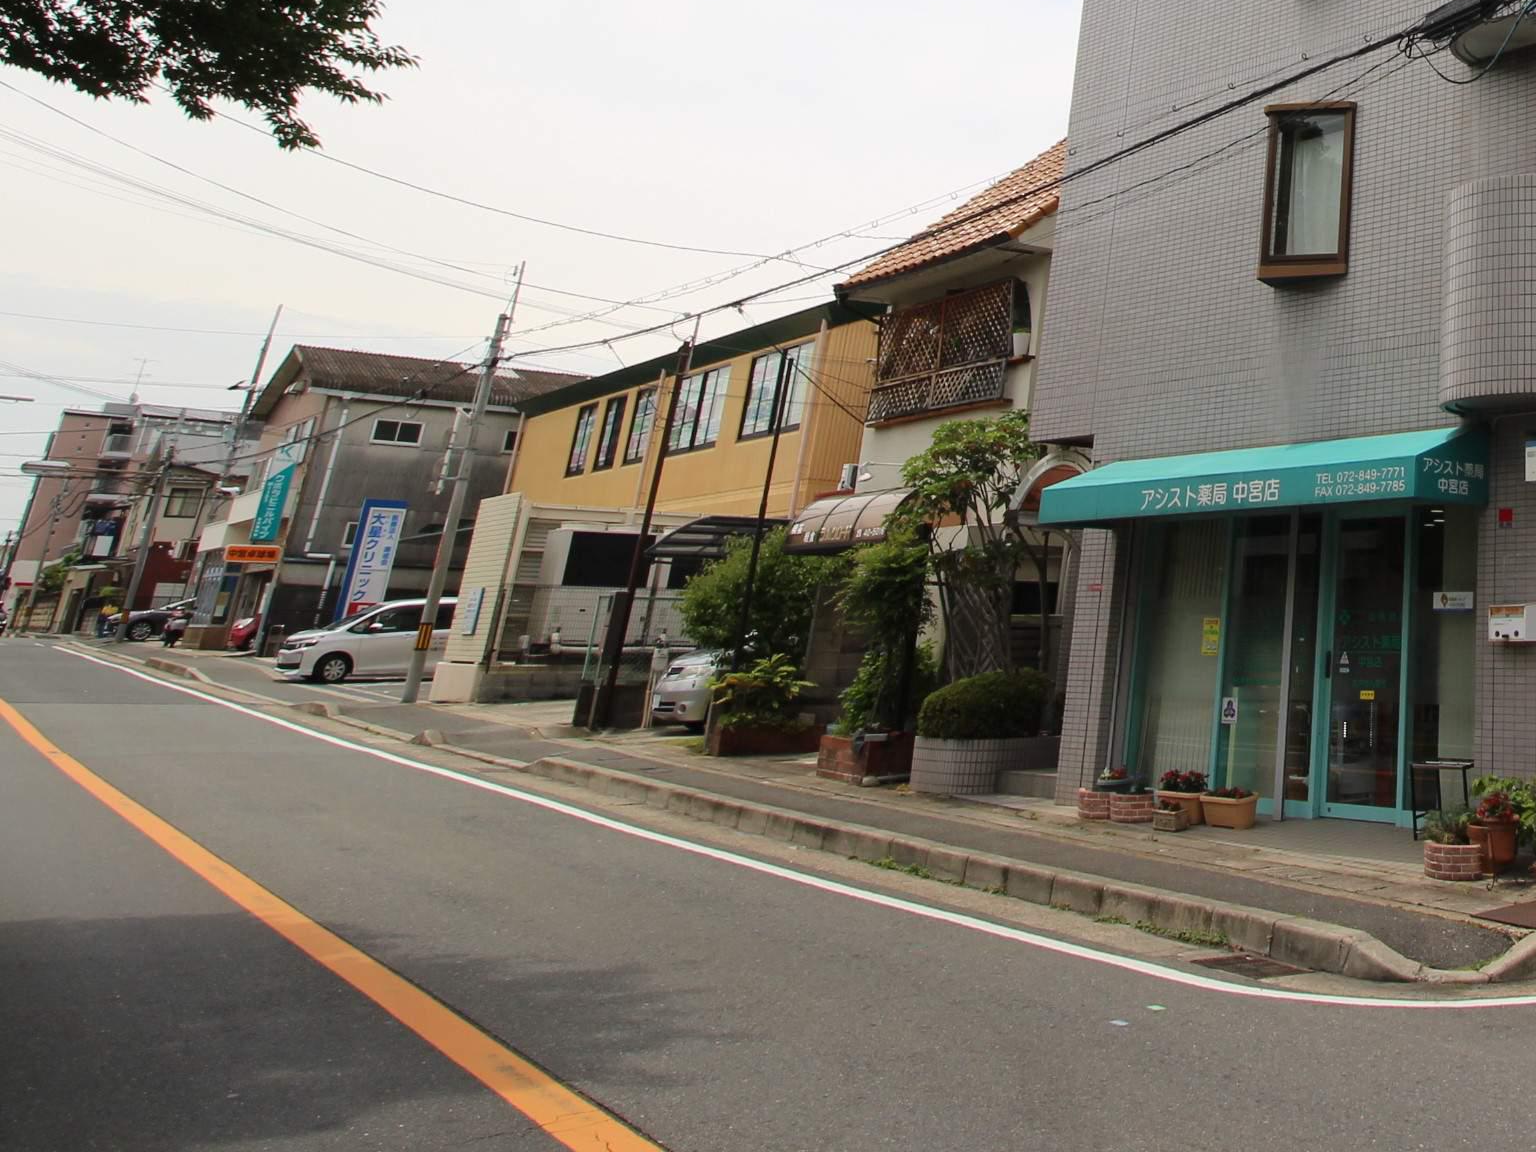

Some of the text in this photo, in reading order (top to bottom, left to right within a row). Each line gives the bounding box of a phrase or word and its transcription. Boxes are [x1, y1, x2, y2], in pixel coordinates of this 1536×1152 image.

[1316, 467, 1405, 485] TEL 072-849-7771
[1423, 457, 1484, 480] アシスト薬局
[1140, 478, 1280, 511] アシスト薬局 中宮店
[1314, 480, 1405, 497] FAX 072-849-7785
[1438, 477, 1469, 496] 中宮店
